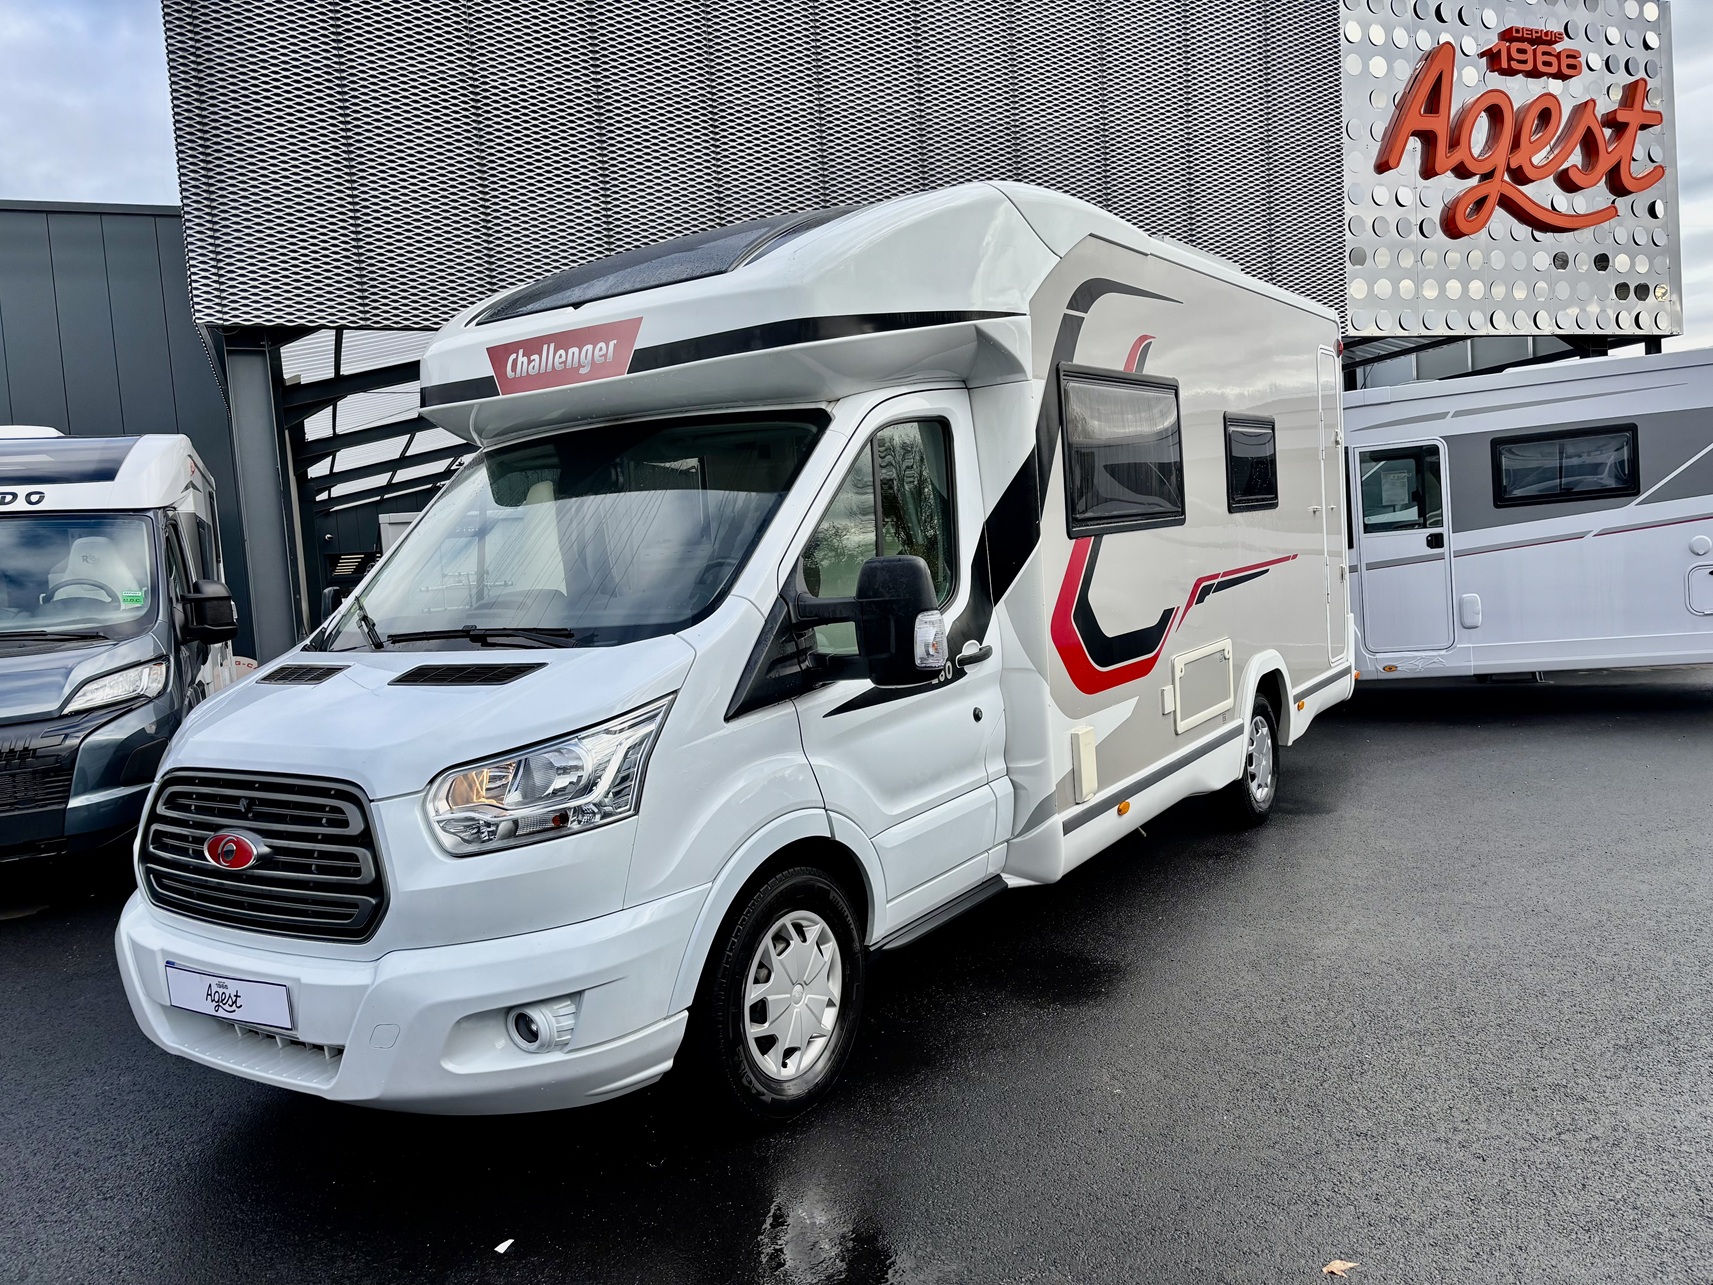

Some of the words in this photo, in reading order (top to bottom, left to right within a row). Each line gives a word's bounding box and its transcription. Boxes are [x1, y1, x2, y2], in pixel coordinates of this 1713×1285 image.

[1512, 26, 1565, 41] DEPUIS
[1491, 40, 1583, 76] 1966
[1376, 41, 1666, 239] Agest
[506, 339, 618, 379] Challenger
[206, 983, 242, 1012] Agest
